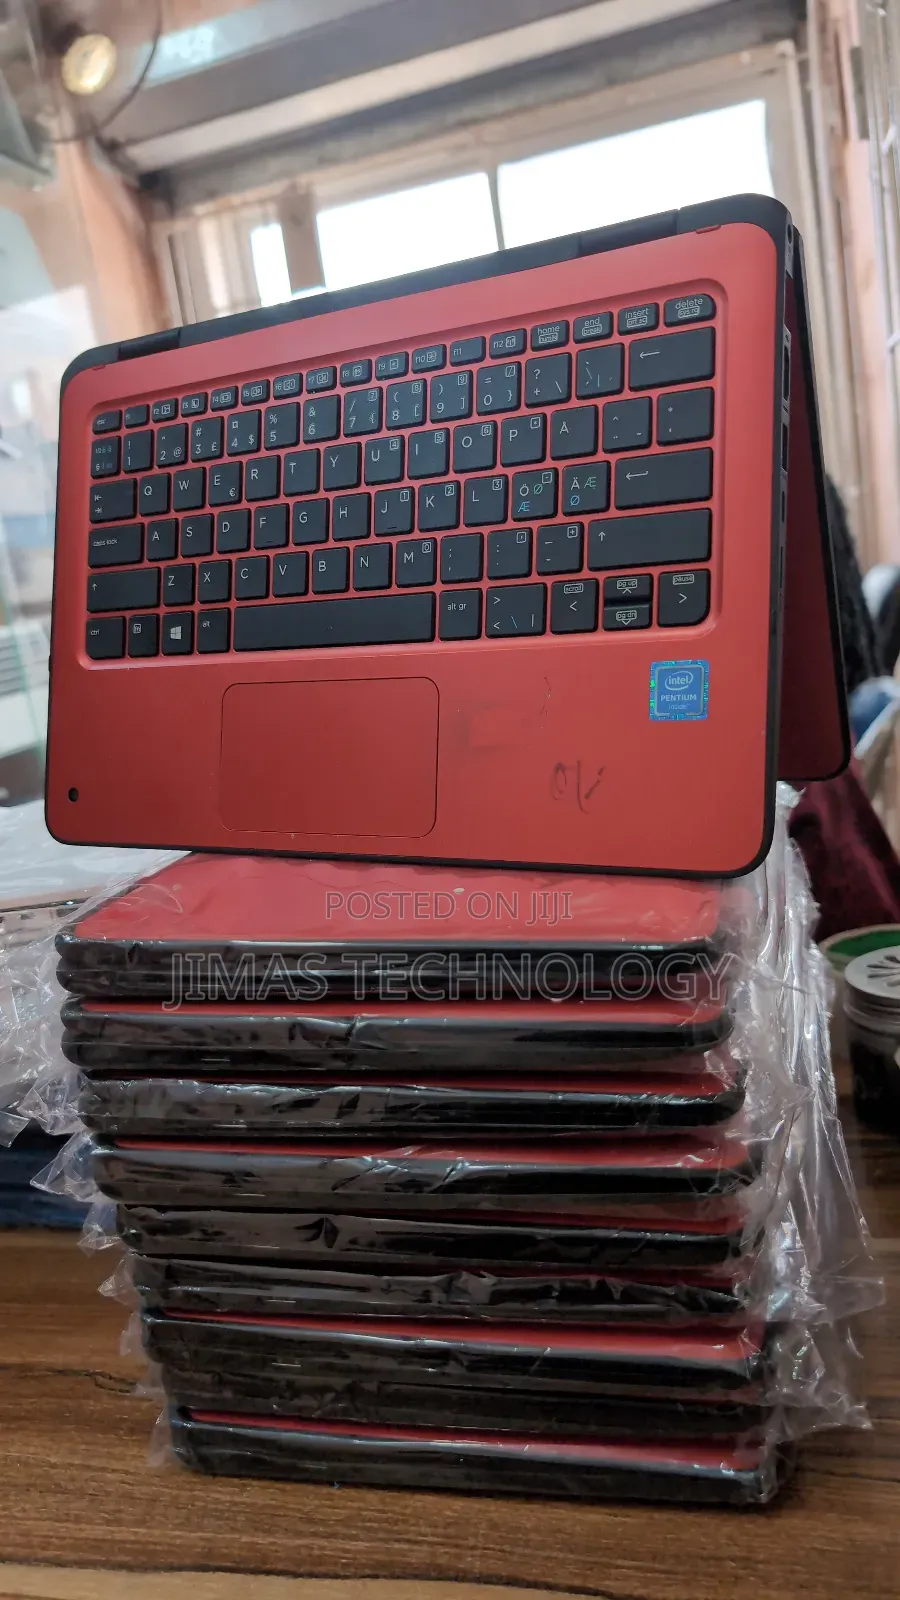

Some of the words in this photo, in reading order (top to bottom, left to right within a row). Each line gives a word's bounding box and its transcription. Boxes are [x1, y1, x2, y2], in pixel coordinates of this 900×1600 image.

[675, 298, 703, 310] delete
[625, 308, 649, 318] insert
[585, 317, 600, 326] end
[538, 326, 560, 335] home
[309, 406, 316, 417] &
[436, 402, 445, 414] 9
[270, 414, 278, 424] %
[392, 410, 400, 421] 8
[350, 417, 356, 429] 7
[559, 421, 569, 434] Å
[196, 428, 202, 437] #
[308, 424, 315, 435] 6
[509, 429, 518, 441] P
[248, 434, 255, 445] $
[270, 431, 277, 442] 5
[462, 436, 472, 448] O
[211, 442, 218, 451] £
[231, 437, 238, 448] 4
[173, 446, 182, 457] @
[195, 444, 202, 455] 3
[415, 443, 419, 455] I
[160, 451, 166, 461] 2
[371, 449, 380, 461] U
[128, 456, 131, 466] 1
[330, 455, 339, 468] Y
[289, 462, 297, 474] T
[250, 469, 259, 480] R
[179, 480, 189, 491] W
[214, 475, 221, 486] E
[570, 477, 580, 491] Ä
[144, 486, 153, 497] Q
[229, 488, 236, 497] €
[447, 486, 453, 494] 2
[520, 484, 529, 497] Ö
[426, 495, 435, 508] K
[472, 490, 480, 502] L
[339, 505, 348, 518] H
[381, 501, 388, 514] J
[259, 517, 267, 529] F
[299, 512, 308, 524] G
[186, 527, 193, 537] S
[222, 522, 230, 533] D
[152, 531, 160, 541] A
[360, 556, 369, 568] N
[403, 551, 414, 563] M
[279, 564, 287, 576] V
[318, 560, 327, 572] B
[203, 571, 211, 583] X
[240, 568, 249, 579] C
[168, 575, 175, 587] Z
[447, 602, 457, 611] alt
[458, 602, 467, 611] gr
[202, 620, 211, 628] alt
[668, 675, 689, 685] intel
[660, 694, 697, 702] PENTIUM
